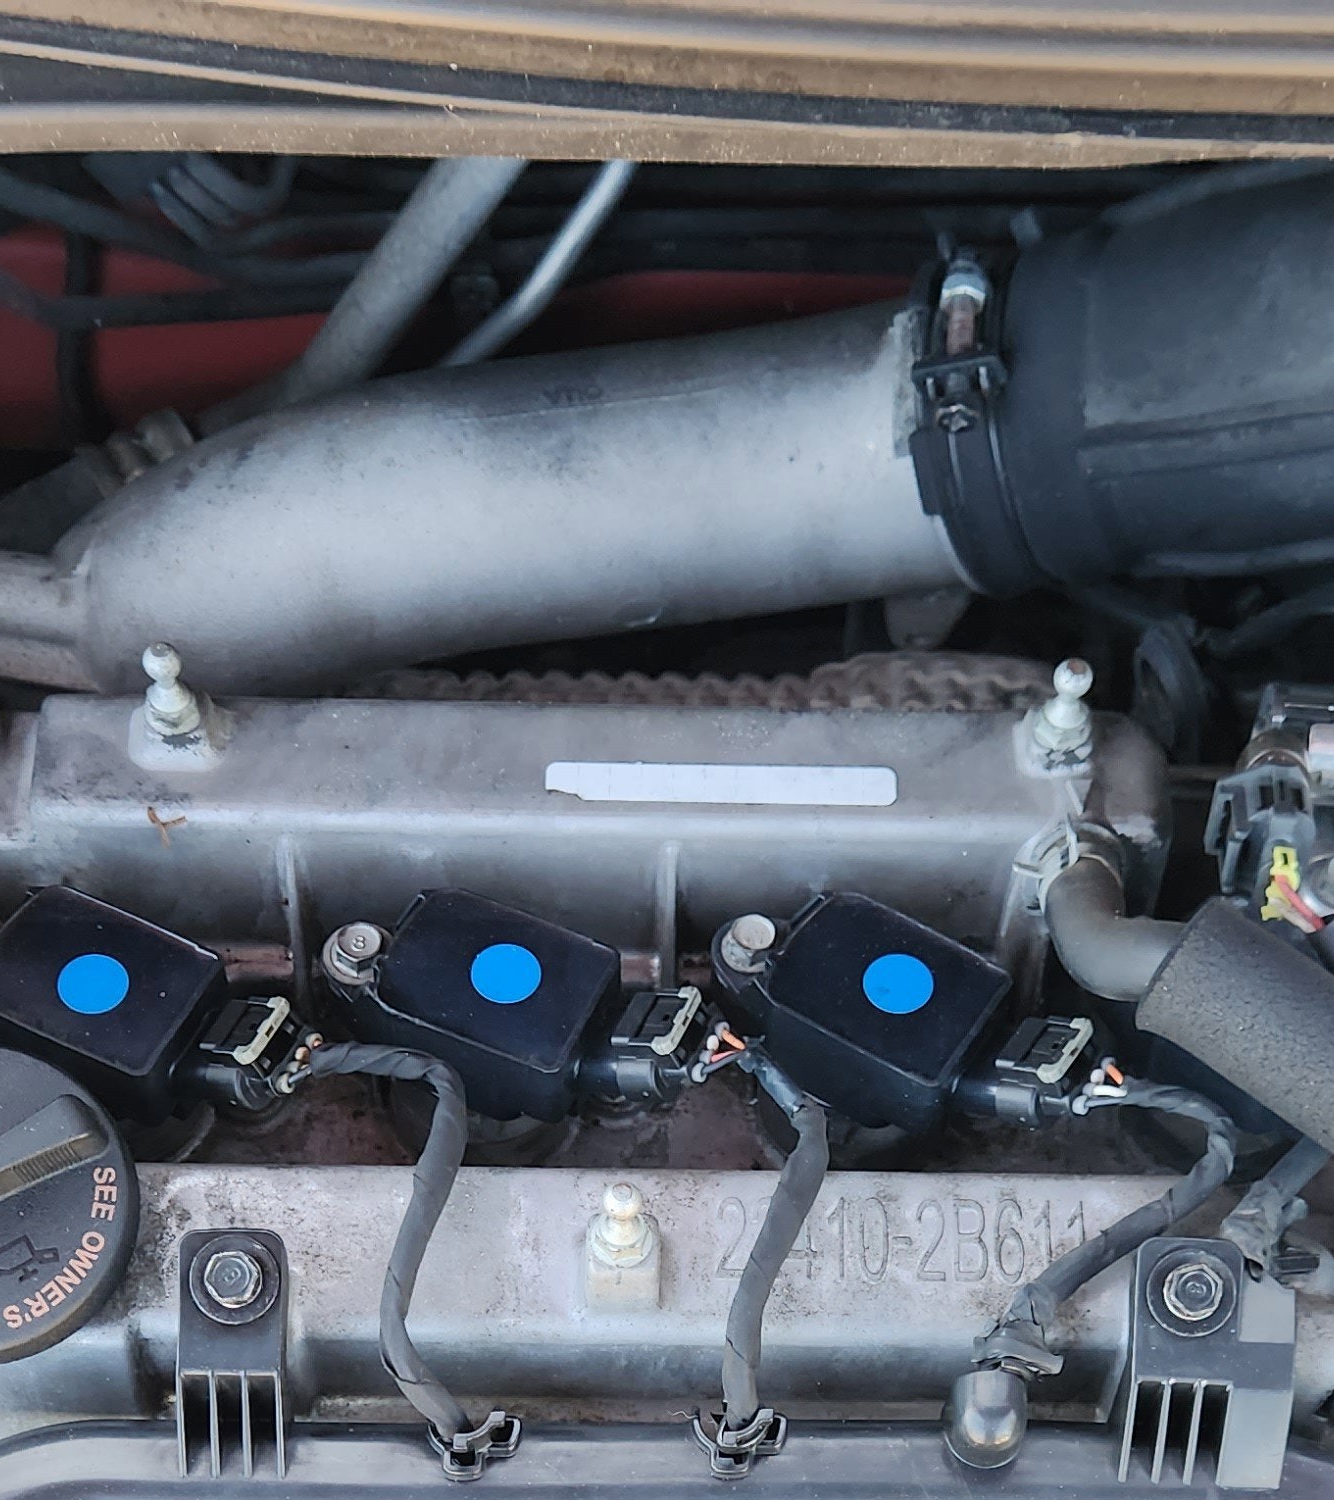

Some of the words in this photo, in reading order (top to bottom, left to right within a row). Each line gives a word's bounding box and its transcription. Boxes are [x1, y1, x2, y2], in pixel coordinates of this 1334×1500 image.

[352, 935, 366, 952] 8
[90, 1166, 116, 1221] SEE
[714, 1196, 1087, 1286] 2410-2B611
[3, 1231, 106, 1329] OWNER'S
